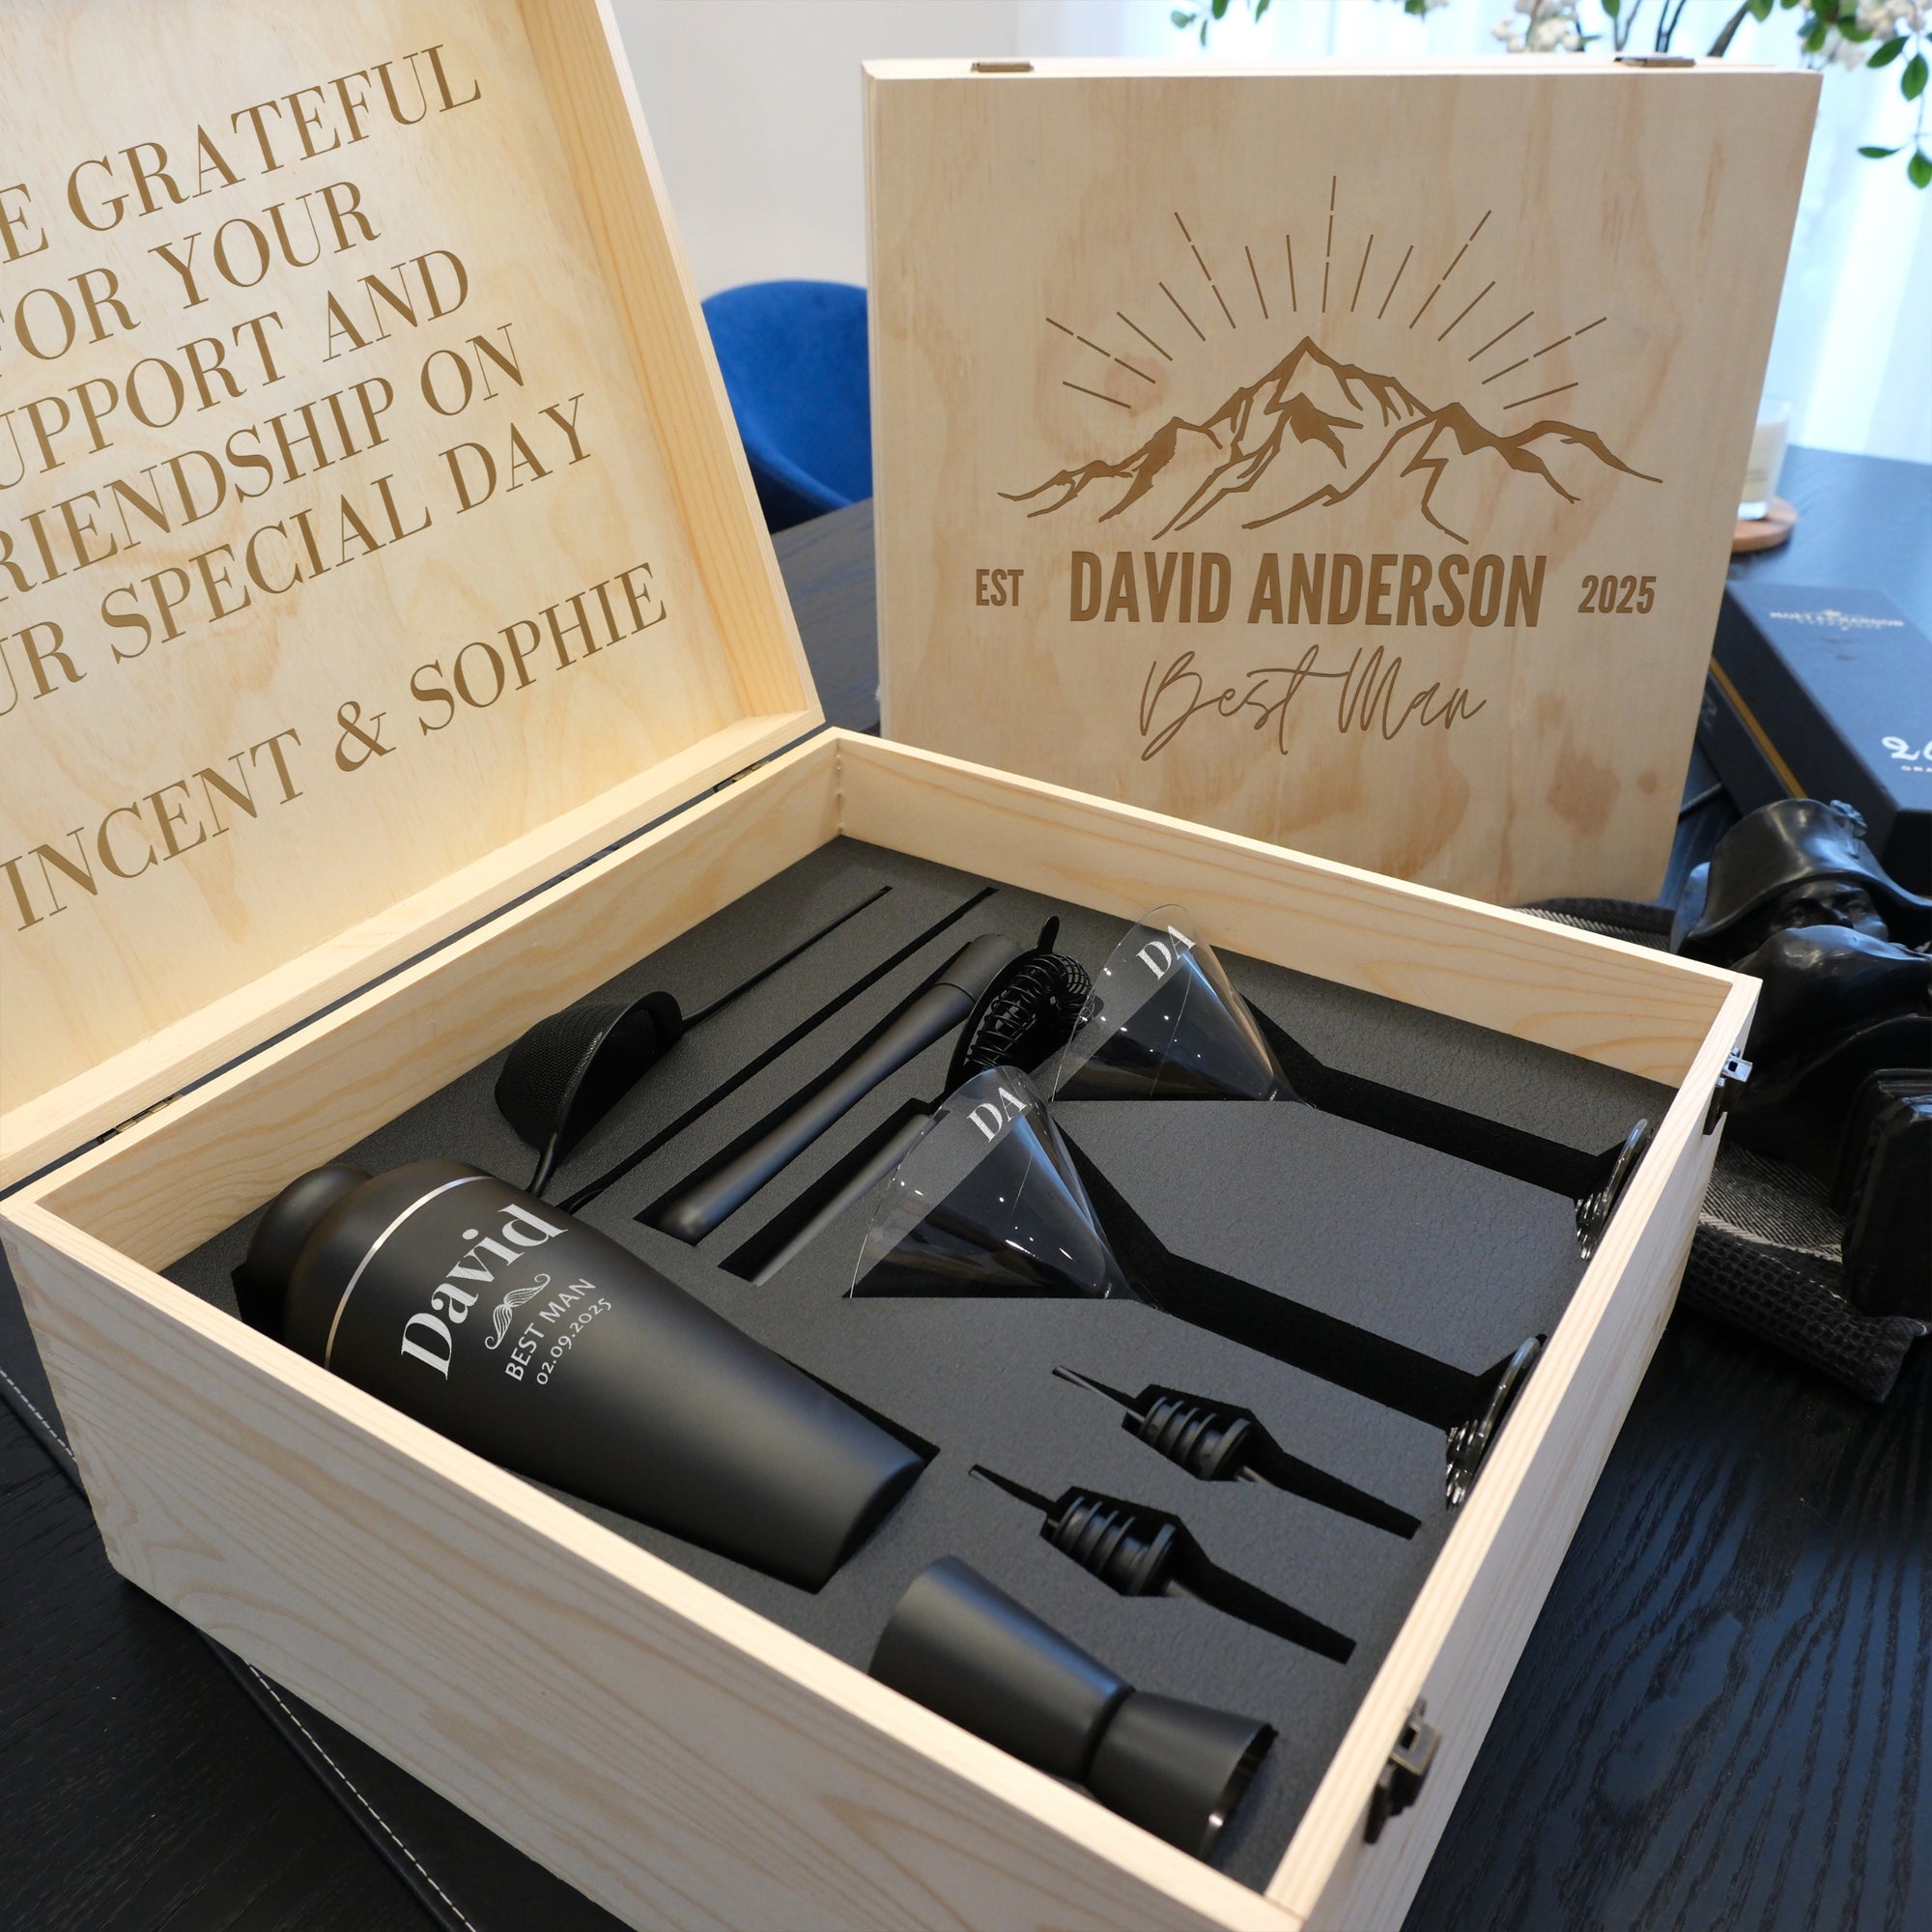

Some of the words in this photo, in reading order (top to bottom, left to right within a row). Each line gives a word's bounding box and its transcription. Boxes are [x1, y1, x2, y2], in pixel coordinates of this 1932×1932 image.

[67, 44, 481, 232] GRATEFUL
[0, 268, 142, 360] OR
[149, 181, 382, 309] YOUR
[323, 250, 469, 362] AND
[420, 323, 525, 416] ON
[0, 621, 87, 717] R
[100, 474, 433, 665] SPECIAL
[439, 393, 591, 515] DAY
[976, 569, 1024, 607] EST
[1069, 551, 1233, 624] DAVID
[1247, 554, 1548, 628] ANDERSON
[1577, 576, 1657, 614] 2025
[0, 728, 303, 931] INCENT
[334, 700, 396, 772] &
[410, 562, 667, 737] SOPHIE
[1139, 644, 1350, 762] Best
[1338, 645, 1488, 741] Man
[1135, 925, 1197, 981] DA
[966, 1087, 1027, 1144] DA
[401, 1204, 569, 1380] David
[504, 1322, 545, 1381] BEST
[538, 1278, 596, 1323] MAN
[536, 1297, 612, 1385] 02.09.2025
